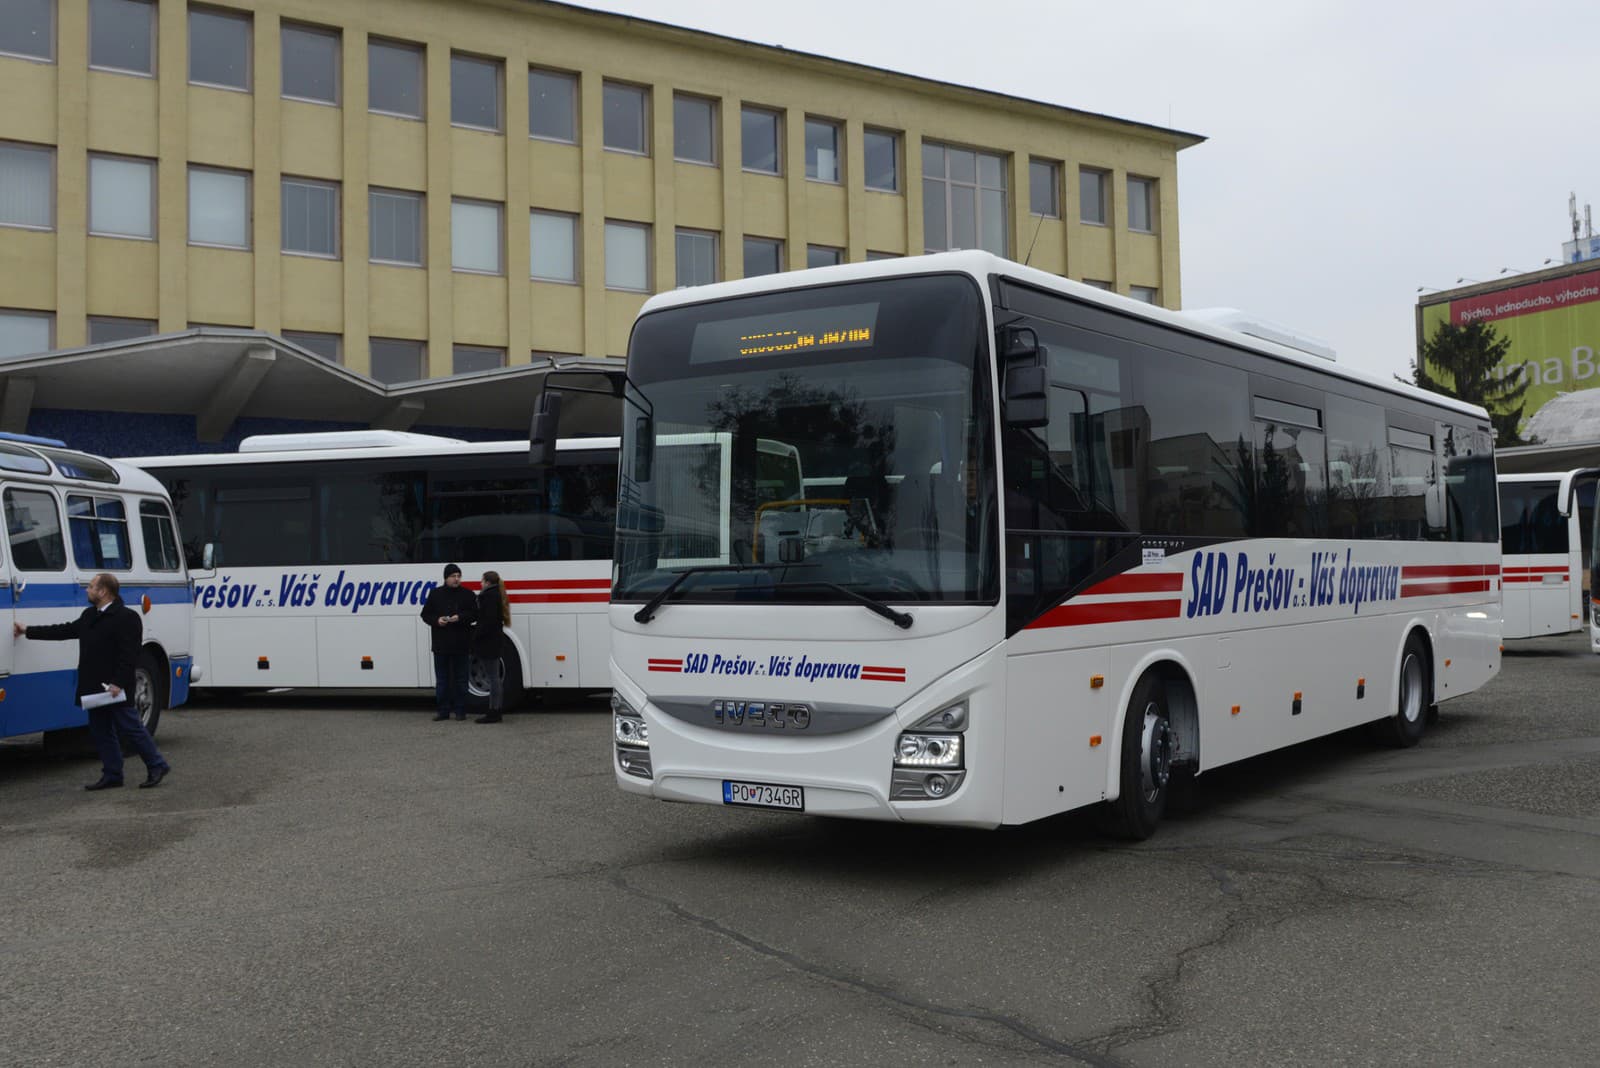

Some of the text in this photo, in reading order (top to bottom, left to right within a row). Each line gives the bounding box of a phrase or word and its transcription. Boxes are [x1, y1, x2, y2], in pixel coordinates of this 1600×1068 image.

[1571, 345, 1600, 380] B
[194, 575, 257, 610] rešov
[278, 573, 321, 608] Váš
[324, 570, 438, 614] dopravca
[1186, 550, 1229, 619] SAD
[1231, 552, 1295, 614] Prešov
[1309, 551, 1338, 607] Váš
[1339, 548, 1399, 615] dopravca
[684, 653, 709, 674] SAD
[711, 654, 756, 676] Prešov
[768, 655, 794, 677] Váš
[794, 655, 861, 683] dopravca
[713, 700, 811, 730] IVECO
